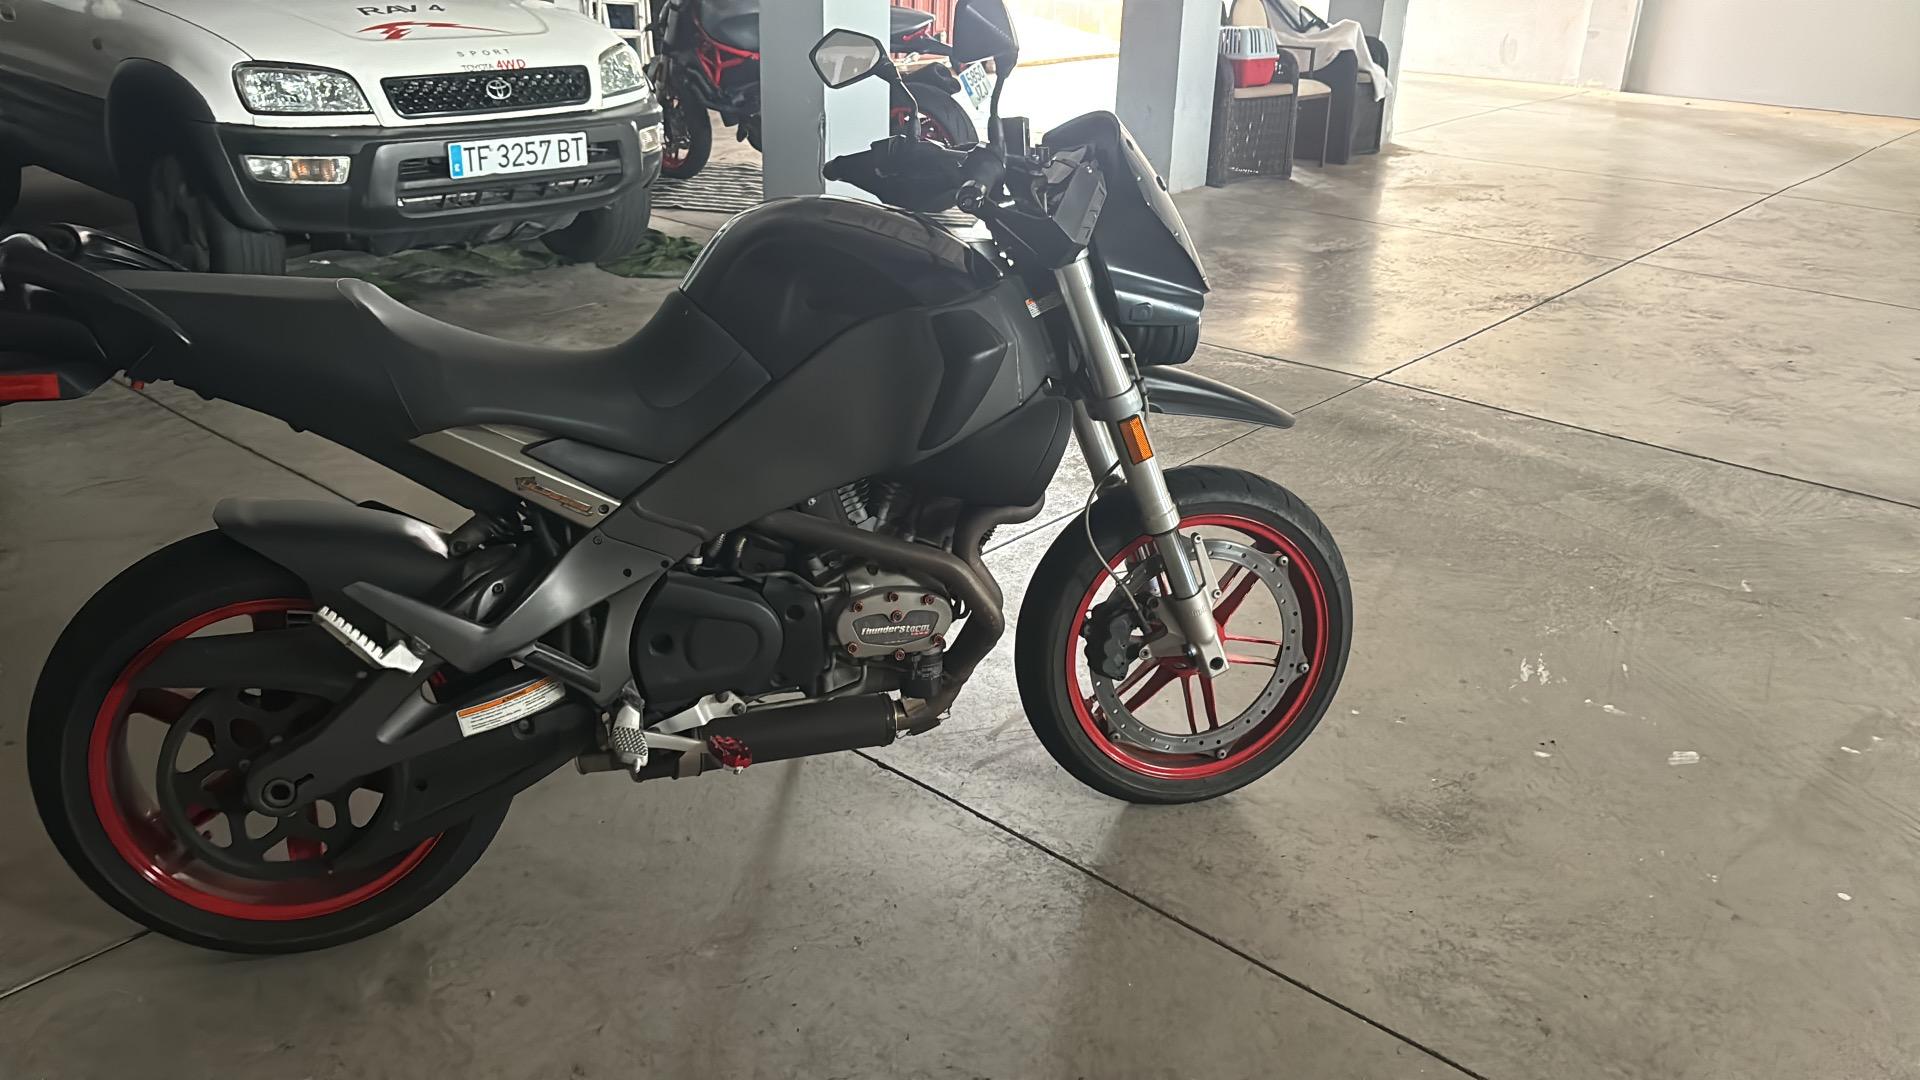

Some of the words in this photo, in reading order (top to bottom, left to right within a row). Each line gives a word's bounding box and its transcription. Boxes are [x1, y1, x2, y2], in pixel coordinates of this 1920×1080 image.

[356, 5, 417, 16] RAV
[428, 4, 446, 12] 4
[456, 49, 511, 58] SPORT
[496, 58, 526, 71] 4WD
[463, 144, 491, 172] TF
[496, 139, 552, 168] 3257
[557, 136, 583, 163] BT
